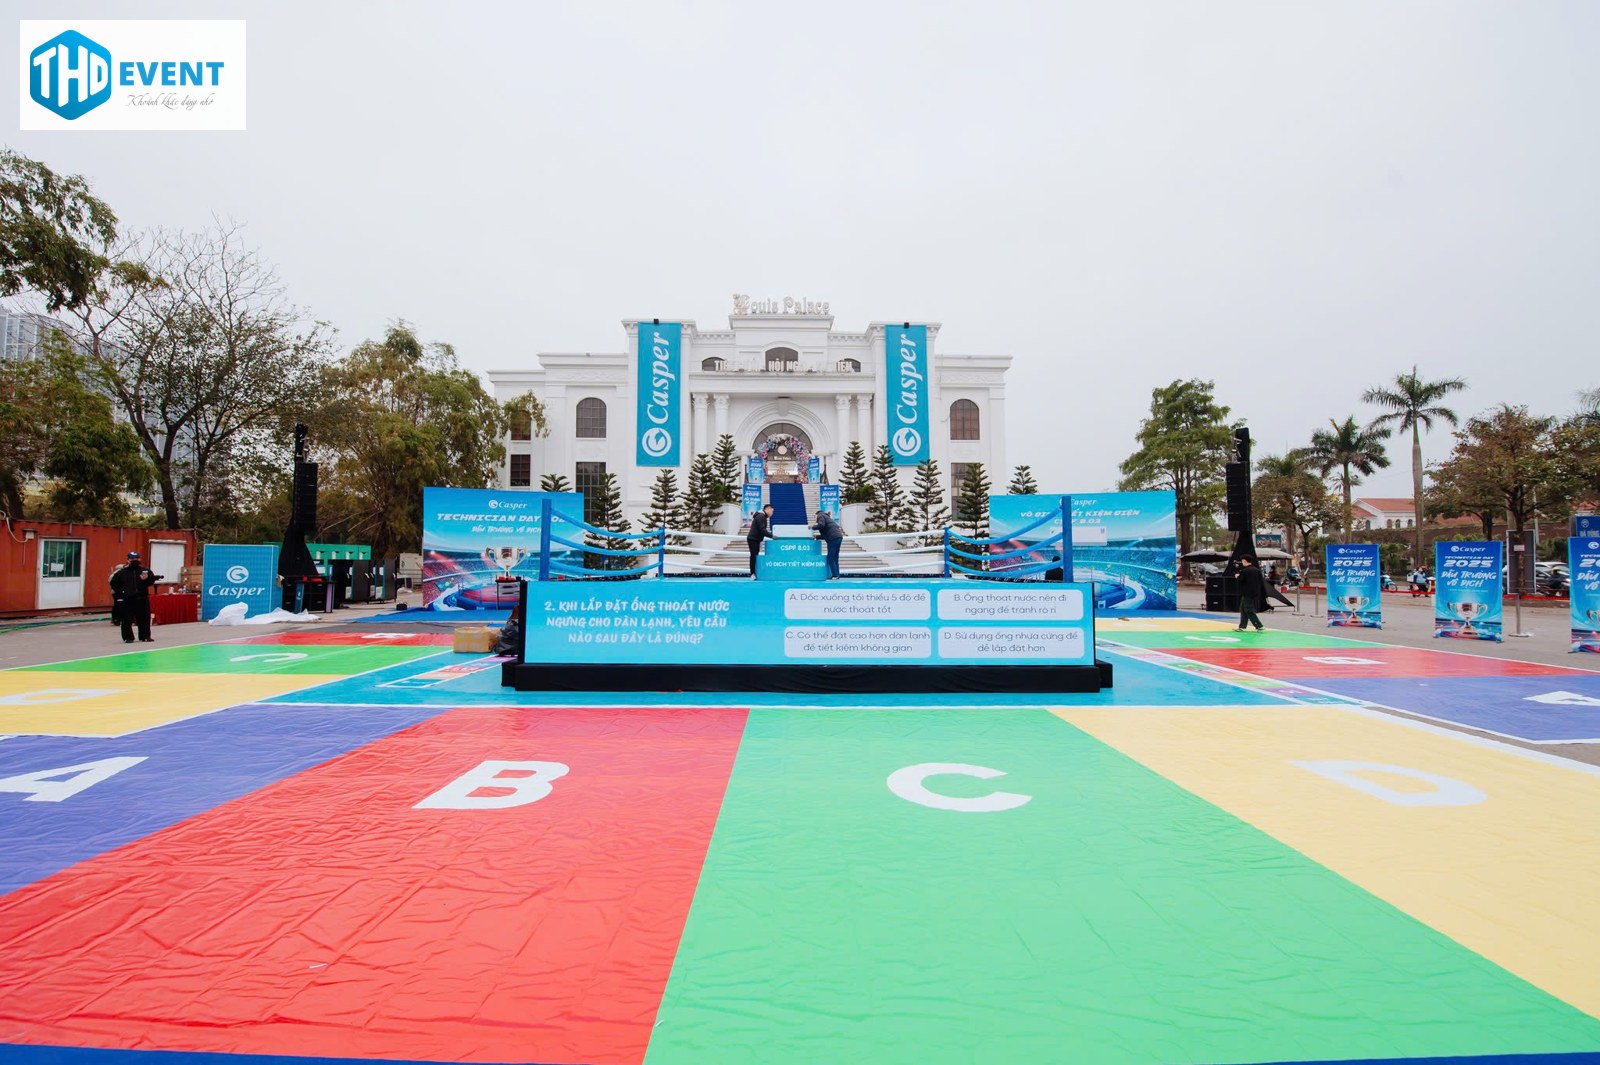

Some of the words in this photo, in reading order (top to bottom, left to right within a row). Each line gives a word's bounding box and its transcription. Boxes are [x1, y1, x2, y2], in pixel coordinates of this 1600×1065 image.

[782, 296, 830, 315] Palace
[647, 331, 675, 425] Casper
[896, 333, 923, 425] Casper
[499, 500, 528, 509] Casper
[1072, 498, 1097, 507] asper
[437, 513, 516, 522] TECHNICIAN
[1443, 559, 1494, 568] 2025
[208, 584, 266, 598] Casper
[544, 601, 555, 611] 2.
[559, 601, 578, 612] KHI
[581, 596, 602, 612] LẮP
[605, 601, 627, 614] ĐẶT
[631, 596, 656, 612] ỐNG
[658, 599, 695, 612] THOÁT
[698, 599, 730, 612] NƯỚC
[965, 606, 995, 615] ngang
[546, 615, 587, 628] NGƯNG
[588, 617, 610, 627] CHO
[614, 615, 638, 627] DÀN
[678, 615, 701, 627] YÊU
[703, 612, 727, 627] CẦU
[568, 631, 592, 644] NÀO
[595, 633, 617, 644] SAU
[620, 631, 645, 644] ĐÂY
[648, 631, 661, 644] LÀ
[665, 631, 704, 645] ĐÚNG?
[892, 644, 912, 653] gian
[0, 757, 149, 802] A
[412, 760, 570, 809] B
[886, 762, 1033, 813] C
[1289, 760, 1488, 806] D
